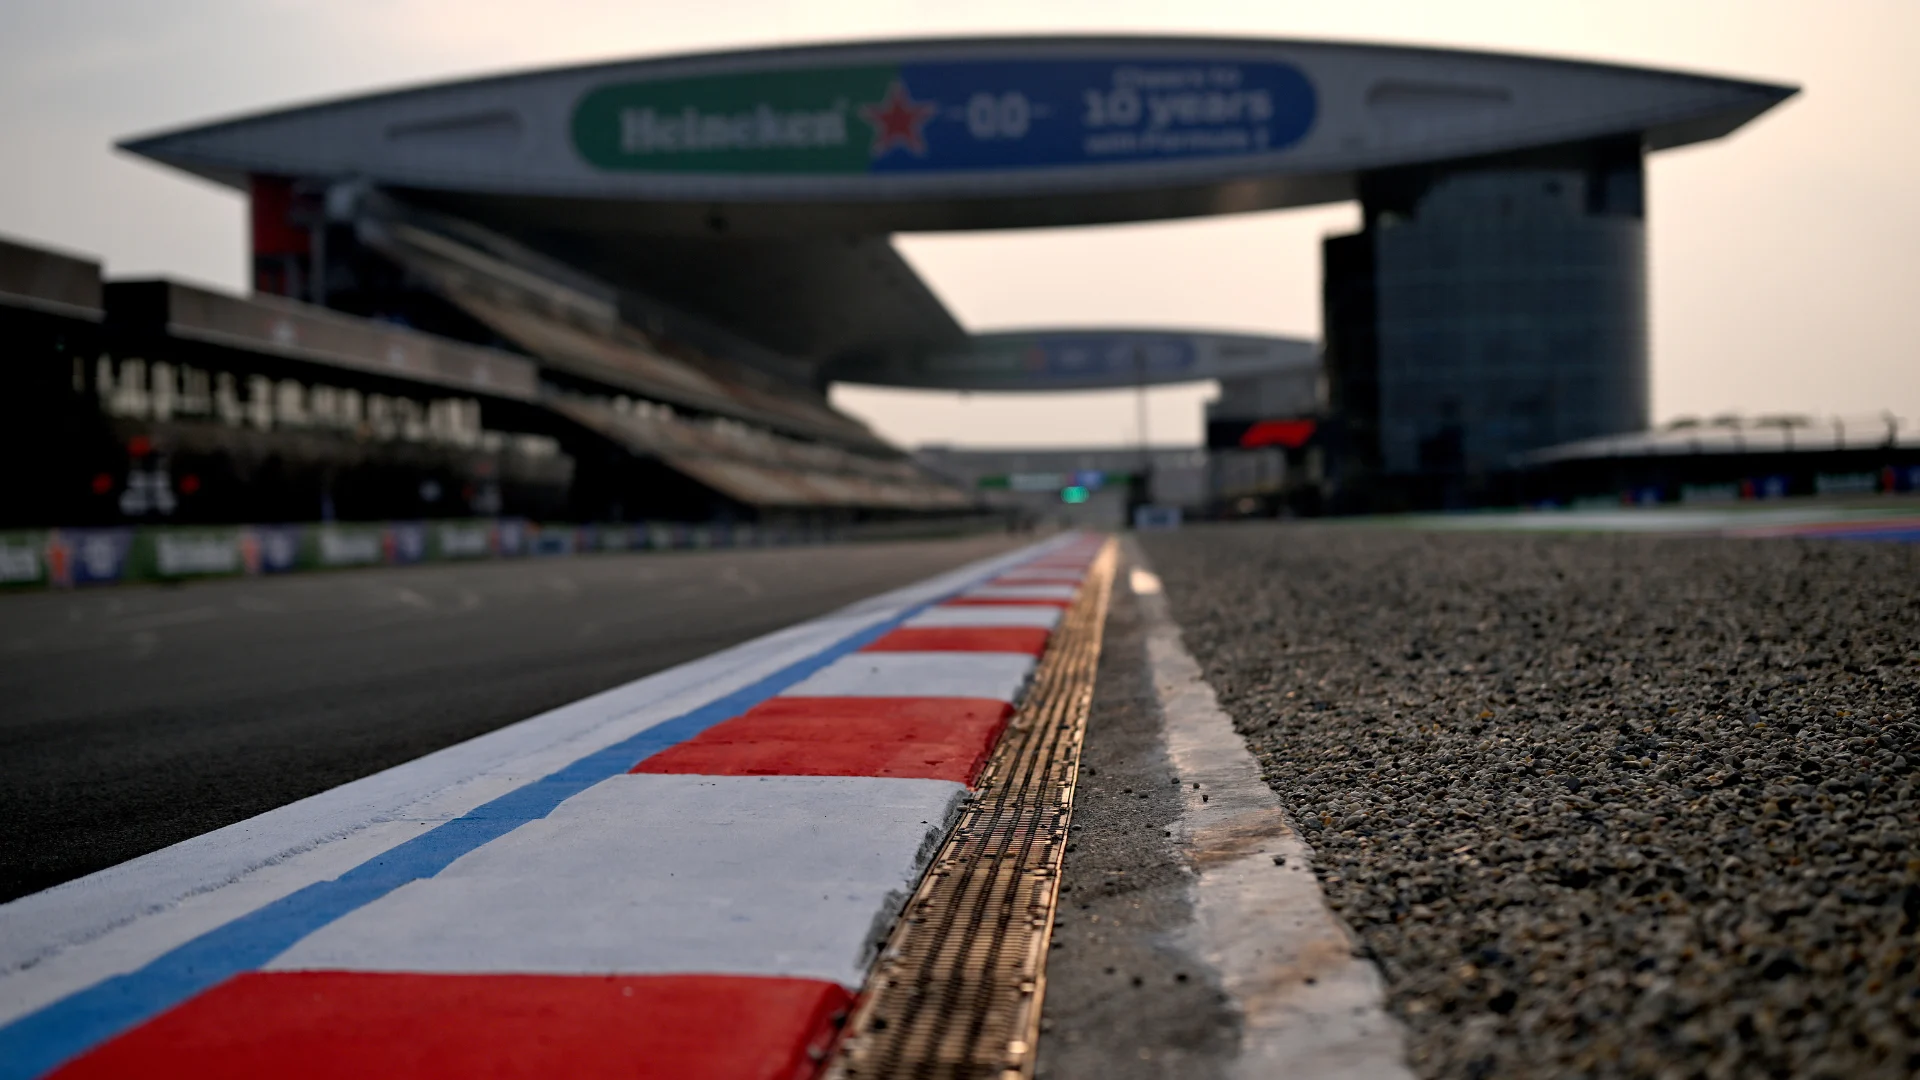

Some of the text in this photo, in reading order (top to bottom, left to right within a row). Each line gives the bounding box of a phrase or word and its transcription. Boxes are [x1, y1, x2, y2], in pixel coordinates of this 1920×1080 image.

[619, 104, 848, 153] Heineken
[1082, 88, 1273, 131] 10 years
